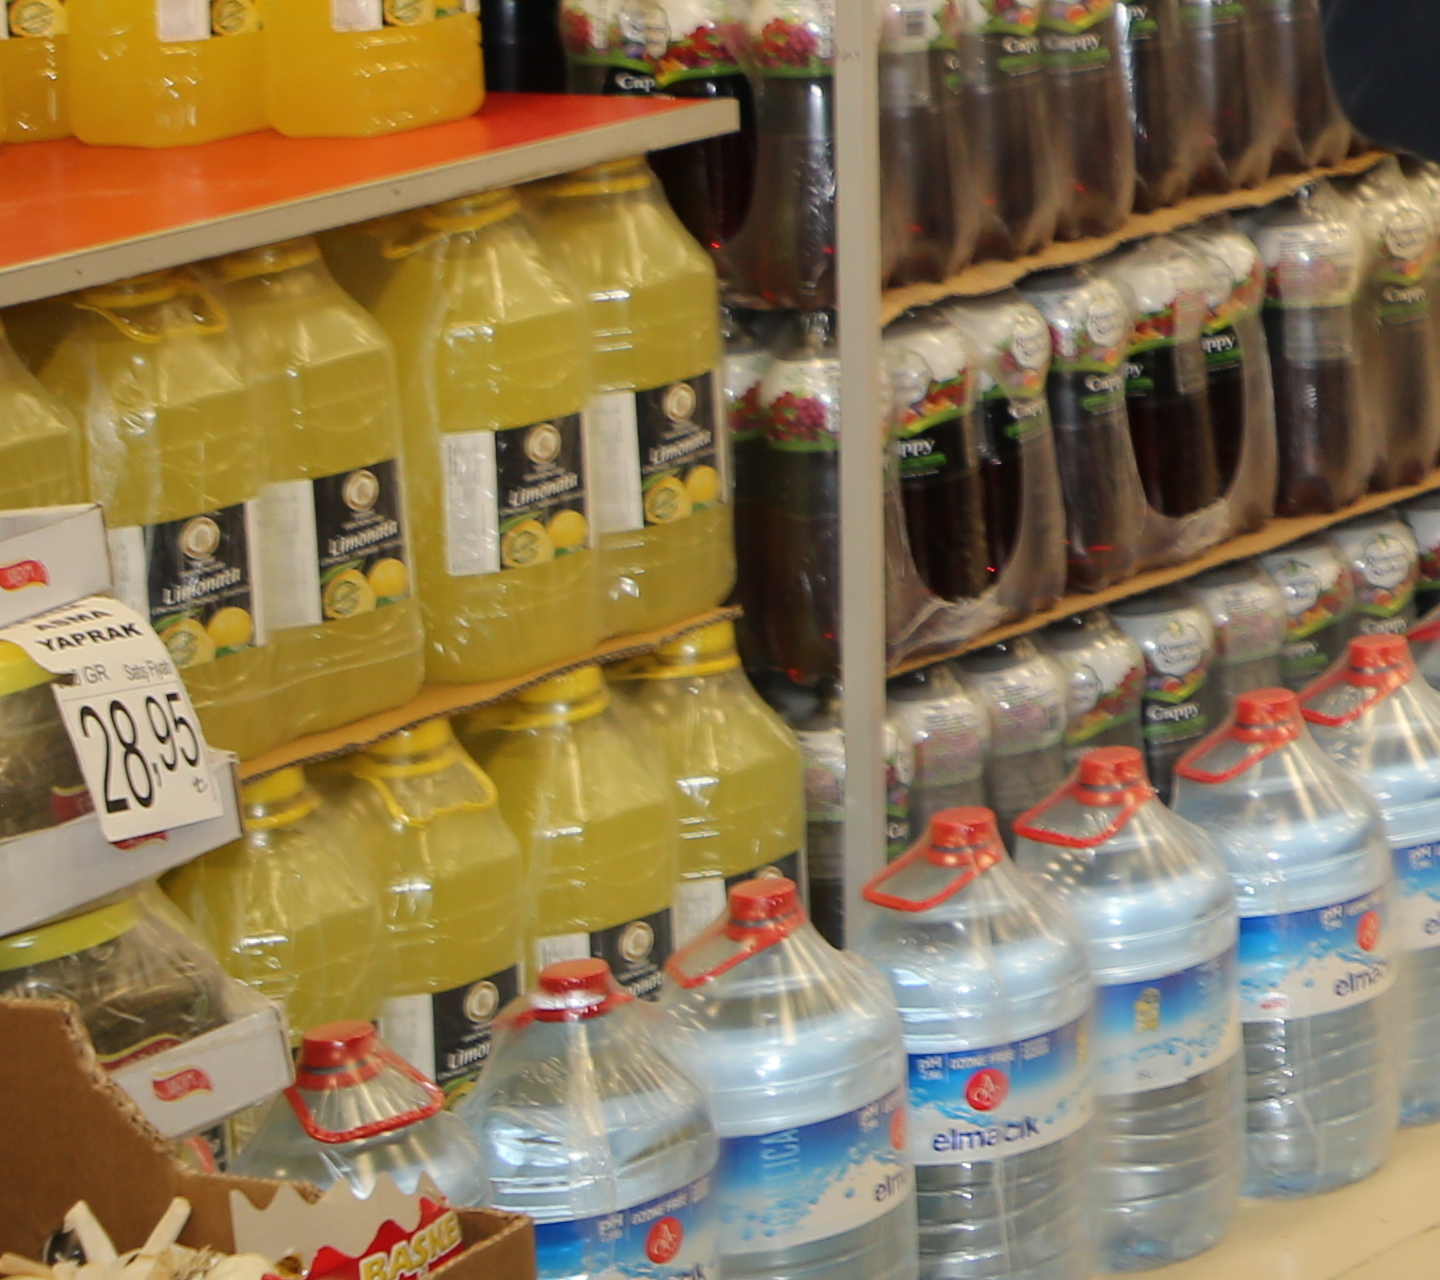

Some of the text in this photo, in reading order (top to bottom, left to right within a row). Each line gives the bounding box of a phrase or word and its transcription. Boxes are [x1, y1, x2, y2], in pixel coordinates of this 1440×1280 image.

[1003, 35, 1039, 54] Capp
[615, 72, 656, 93] Cap
[509, 472, 579, 507] Limonata
[328, 518, 399, 557] Limonata
[162, 567, 242, 606] Limonata
[36, 608, 114, 632] ASMA
[36, 622, 145, 652] YAPRAK
[85, 663, 110, 683] GR
[1149, 702, 1200, 722] Cappy
[80, 692, 199, 815] 28,95
